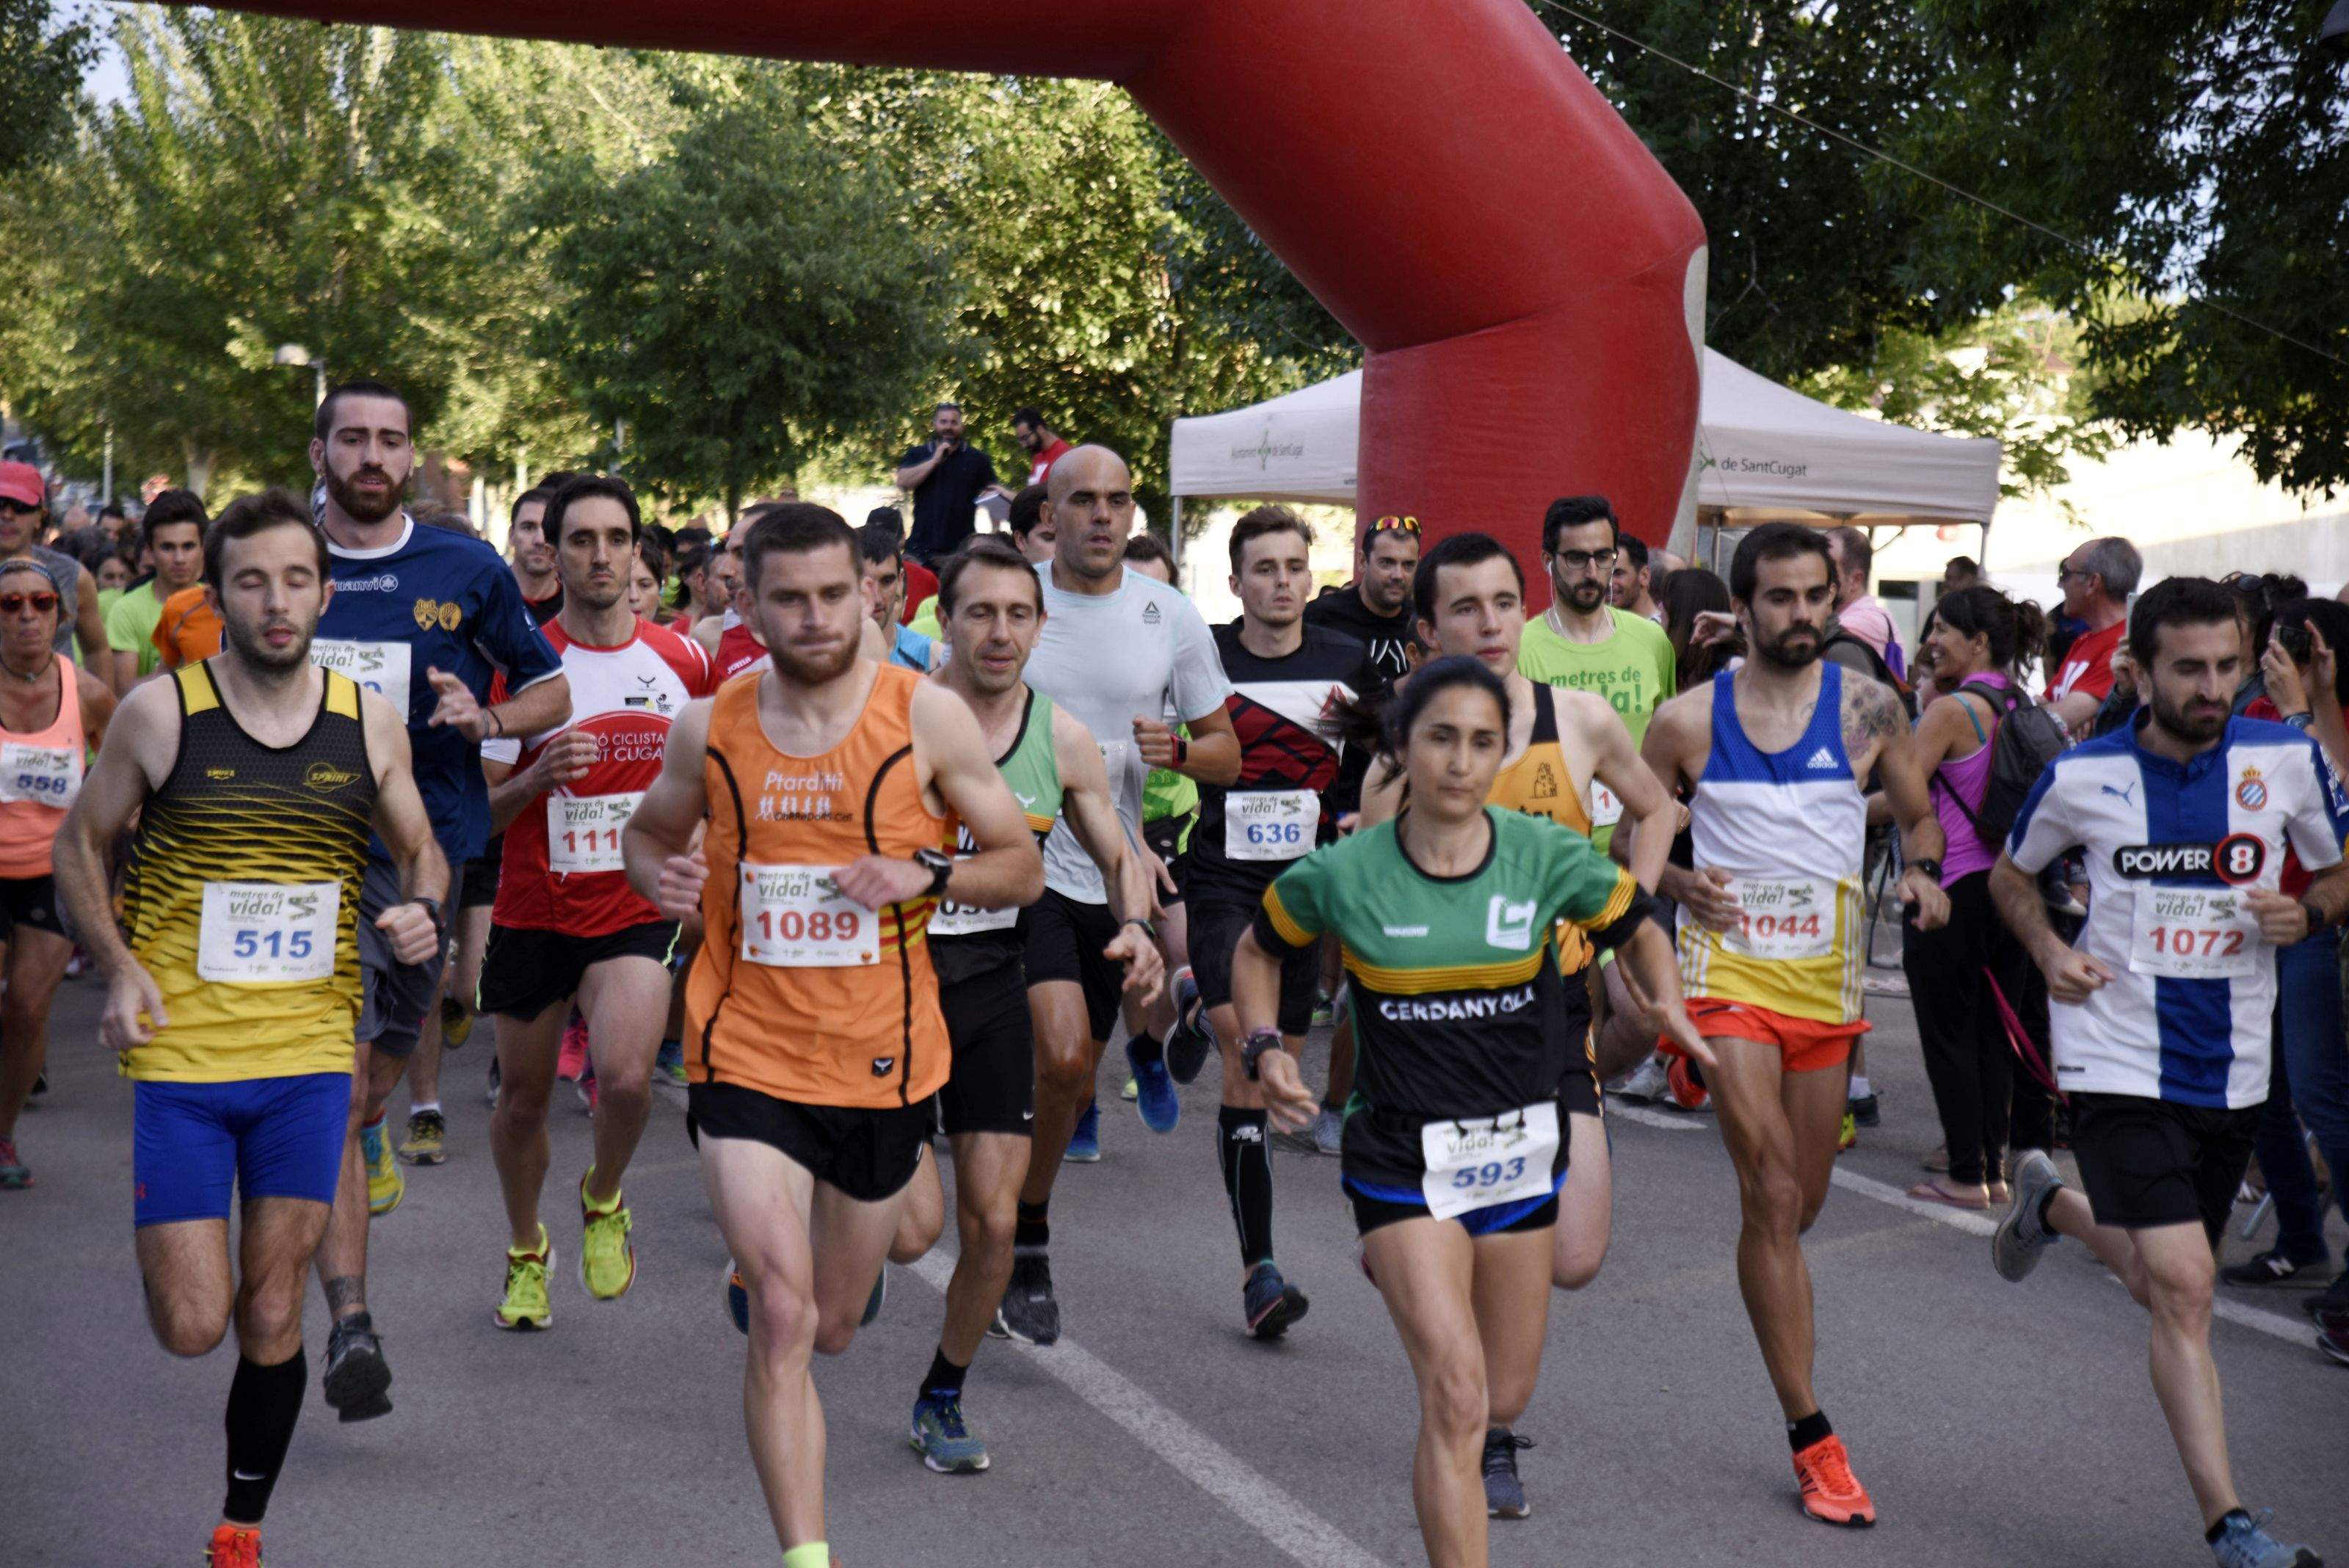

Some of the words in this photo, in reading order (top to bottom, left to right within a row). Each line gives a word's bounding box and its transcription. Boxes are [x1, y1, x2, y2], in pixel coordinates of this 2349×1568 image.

[1721, 457, 1738, 471] de
[1740, 458, 1808, 479] SantCugat
[344, 644, 356, 653] de
[310, 653, 355, 667] vida!
[1550, 669, 1616, 687] metres
[1621, 666, 1641, 683] de
[612, 733, 665, 746] CICLISTA
[595, 799, 606, 807] de
[1241, 800, 1277, 814] vida!
[564, 807, 604, 821] vida!
[1246, 823, 1301, 844] 636
[2121, 849, 2211, 873] POWER
[2229, 845, 2254, 874] 8
[758, 871, 795, 880] metres
[797, 871, 811, 880] de
[229, 889, 269, 899] metres
[271, 889, 285, 899] de
[758, 881, 811, 898] vida!
[1774, 882, 1786, 891] de
[1742, 890, 1785, 904] vida!
[2155, 891, 2191, 901] metres
[2193, 893, 2206, 902] de
[229, 899, 283, 915] vida!
[2155, 900, 2206, 917] vida!
[757, 910, 860, 942] 1089
[1741, 913, 1820, 940] 1044
[233, 929, 313, 959] 515
[2149, 925, 2245, 957] 1072
[1379, 984, 1536, 1022] CERDANYOLA
[1451, 1156, 1526, 1188] 593
